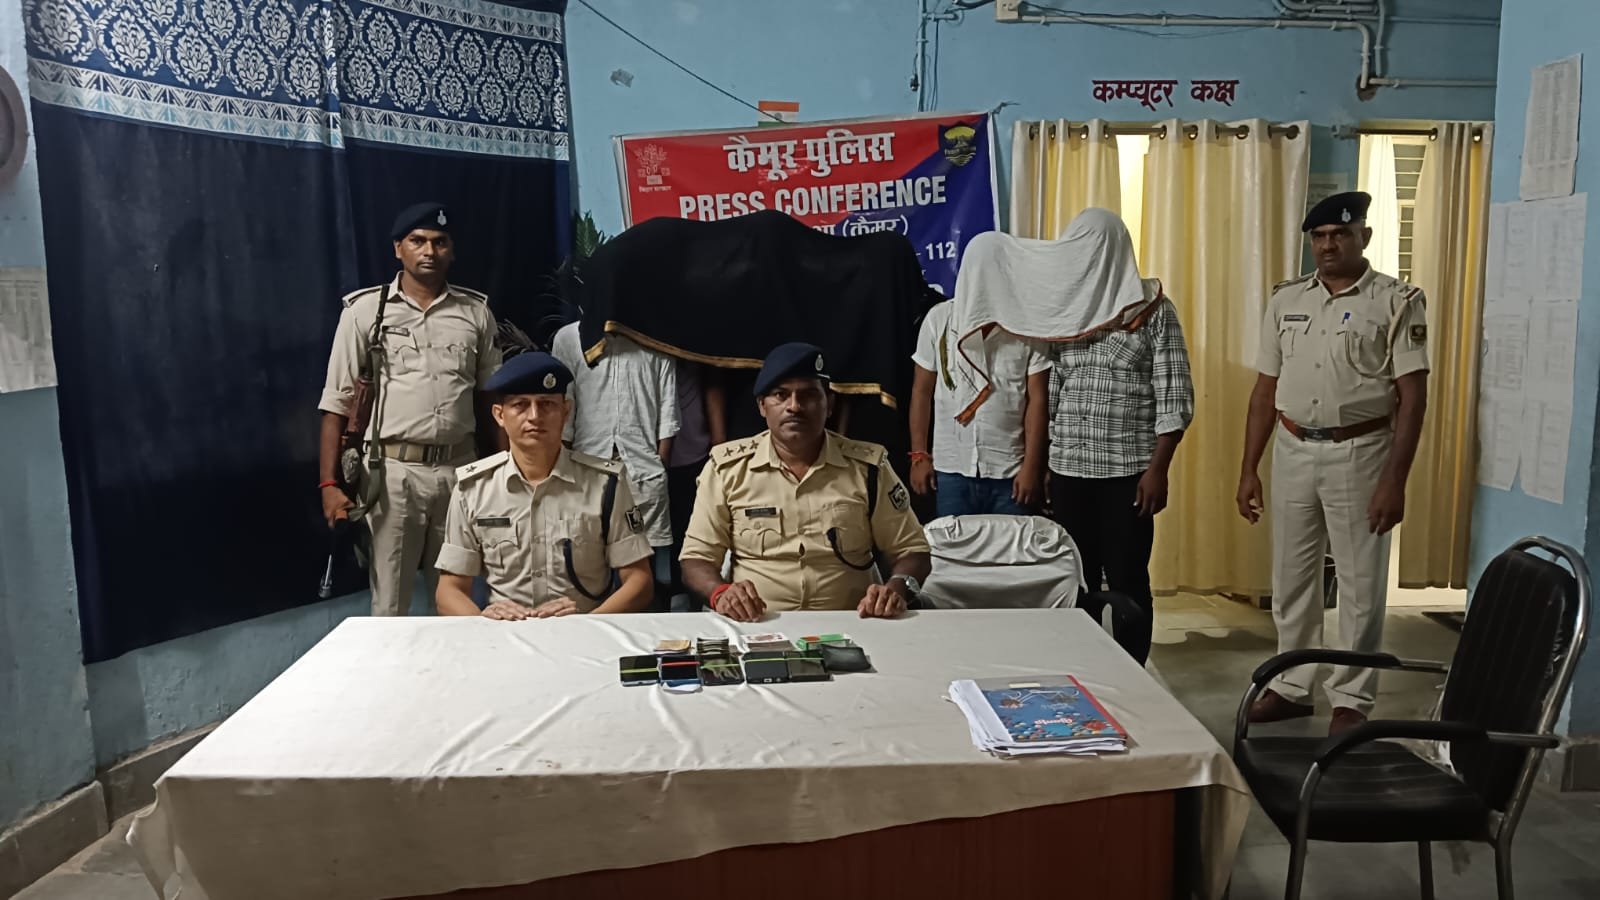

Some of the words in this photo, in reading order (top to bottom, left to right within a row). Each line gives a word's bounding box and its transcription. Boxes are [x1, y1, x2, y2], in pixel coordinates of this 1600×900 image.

[1092, 79, 1178, 111] कम्प्यूटर
[1190, 79, 1240, 106] कक्ष
[723, 136, 798, 180] कैमूर
[803, 129, 895, 177] पुलिस
[679, 190, 765, 222] PRESS
[774, 175, 947, 217] CONFERENCE
[925, 241, 956, 260] 112
